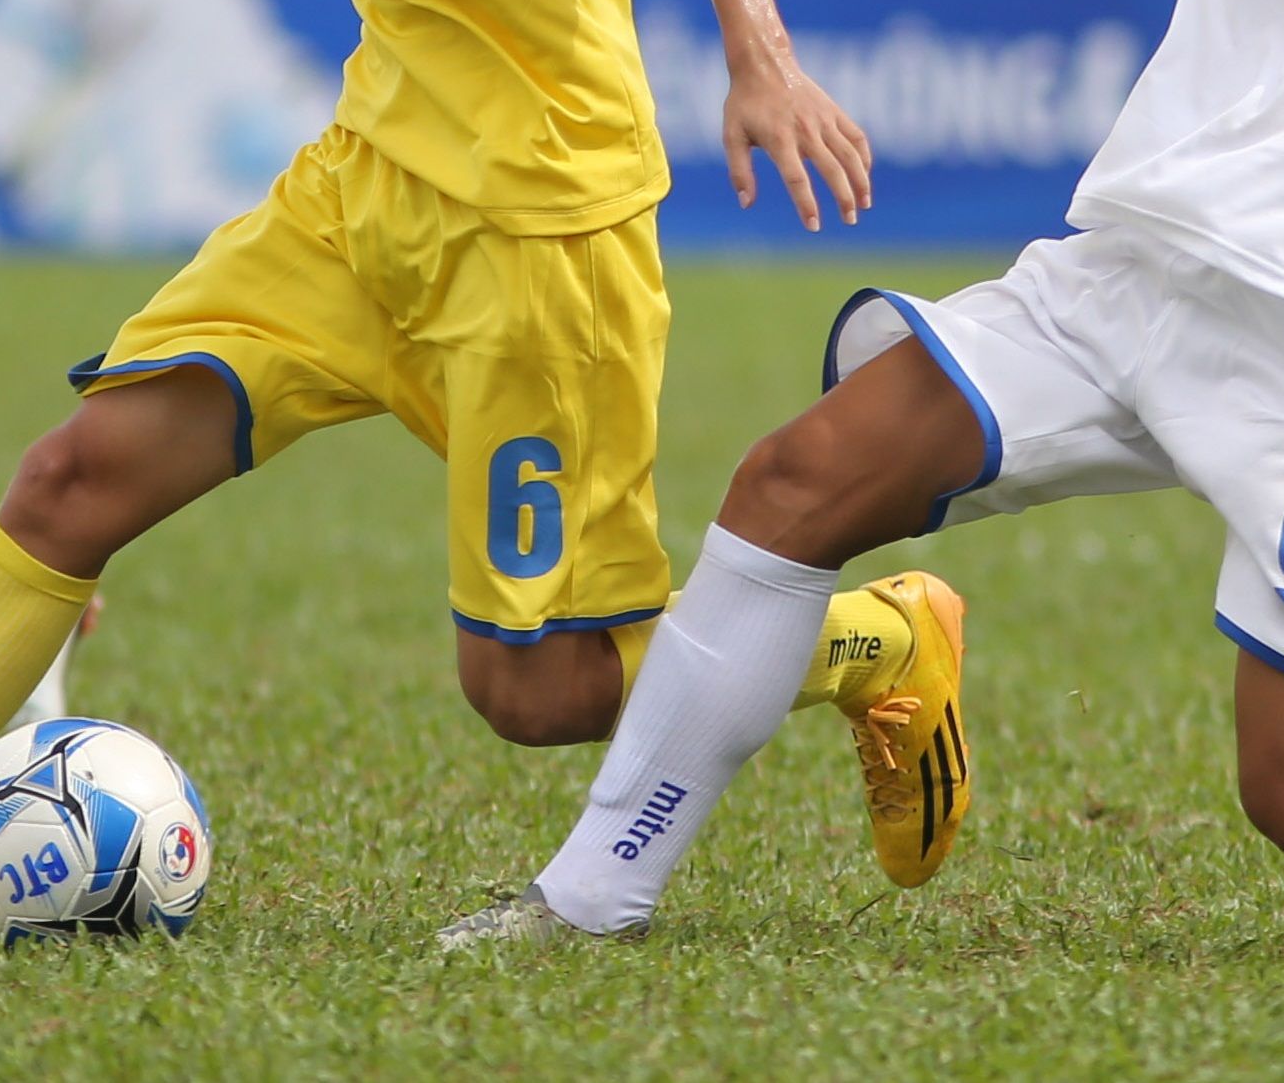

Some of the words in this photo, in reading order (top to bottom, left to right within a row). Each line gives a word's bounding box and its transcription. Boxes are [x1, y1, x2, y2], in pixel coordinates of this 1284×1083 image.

[487, 435, 563, 578] 6
[828, 629, 882, 667] mitre
[612, 780, 688, 861] mitre
